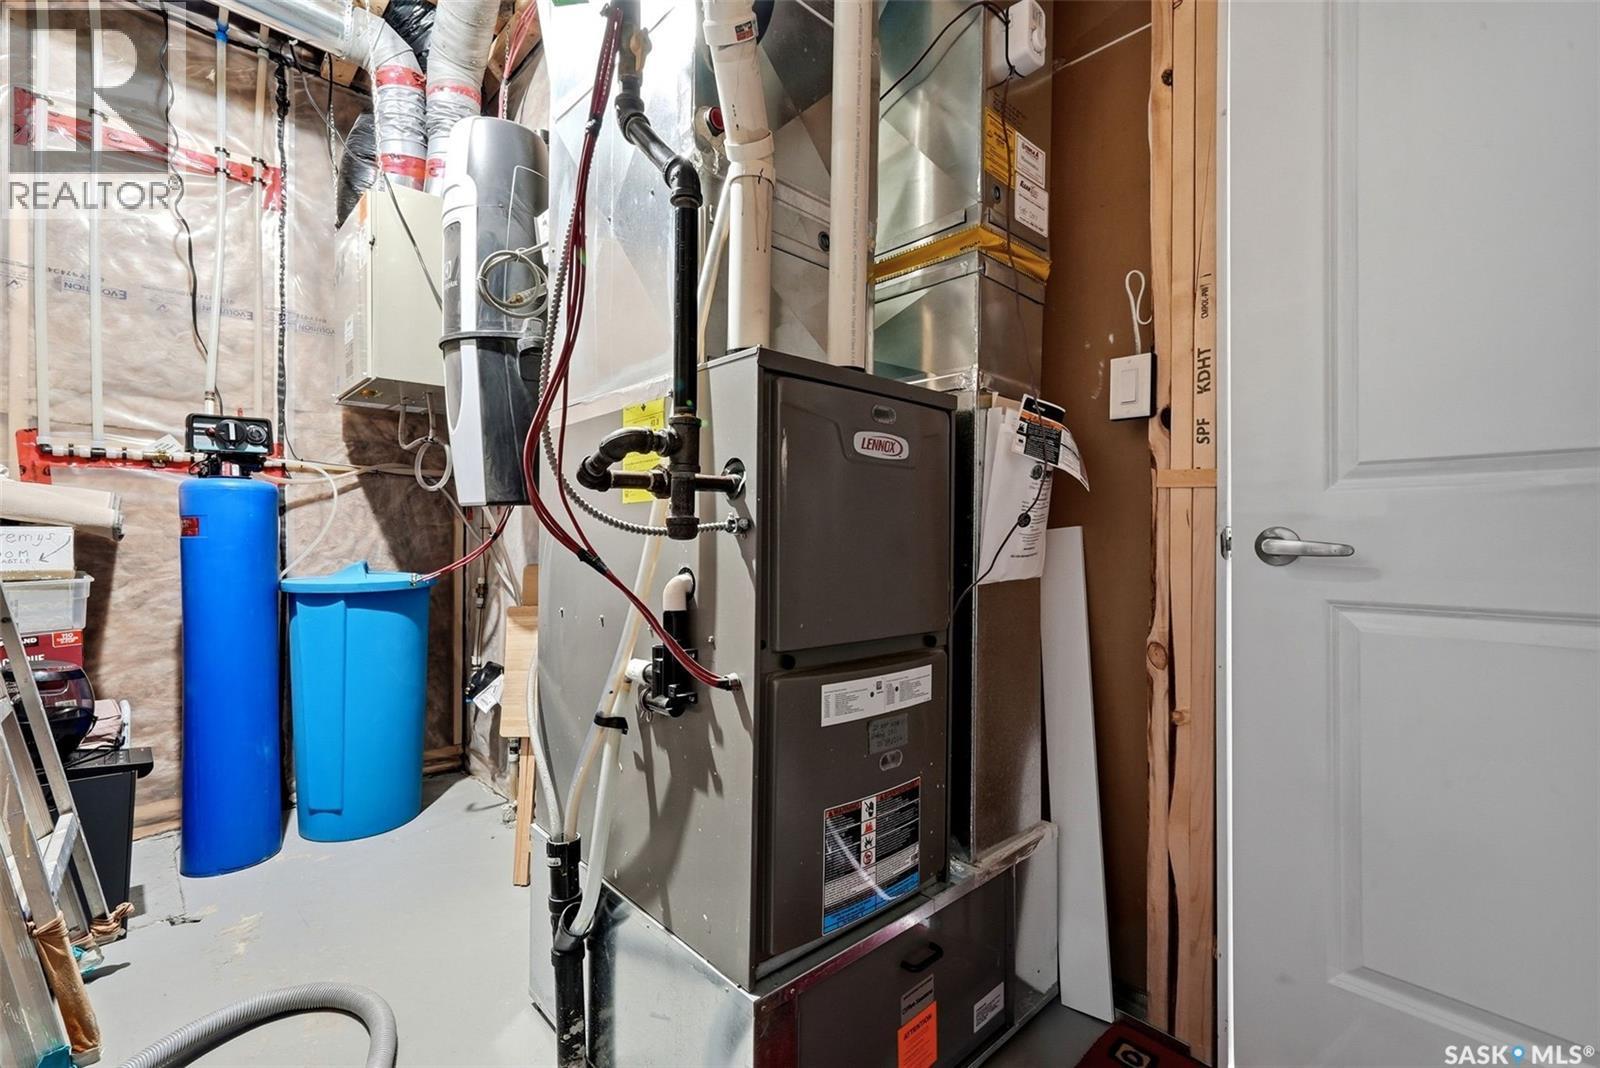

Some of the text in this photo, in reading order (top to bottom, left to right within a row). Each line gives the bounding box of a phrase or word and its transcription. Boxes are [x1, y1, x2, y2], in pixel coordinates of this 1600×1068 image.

[1196, 348, 1212, 395] KDHT
[861, 437, 896, 453] LENNOX
[1196, 418, 1210, 445] SPF
